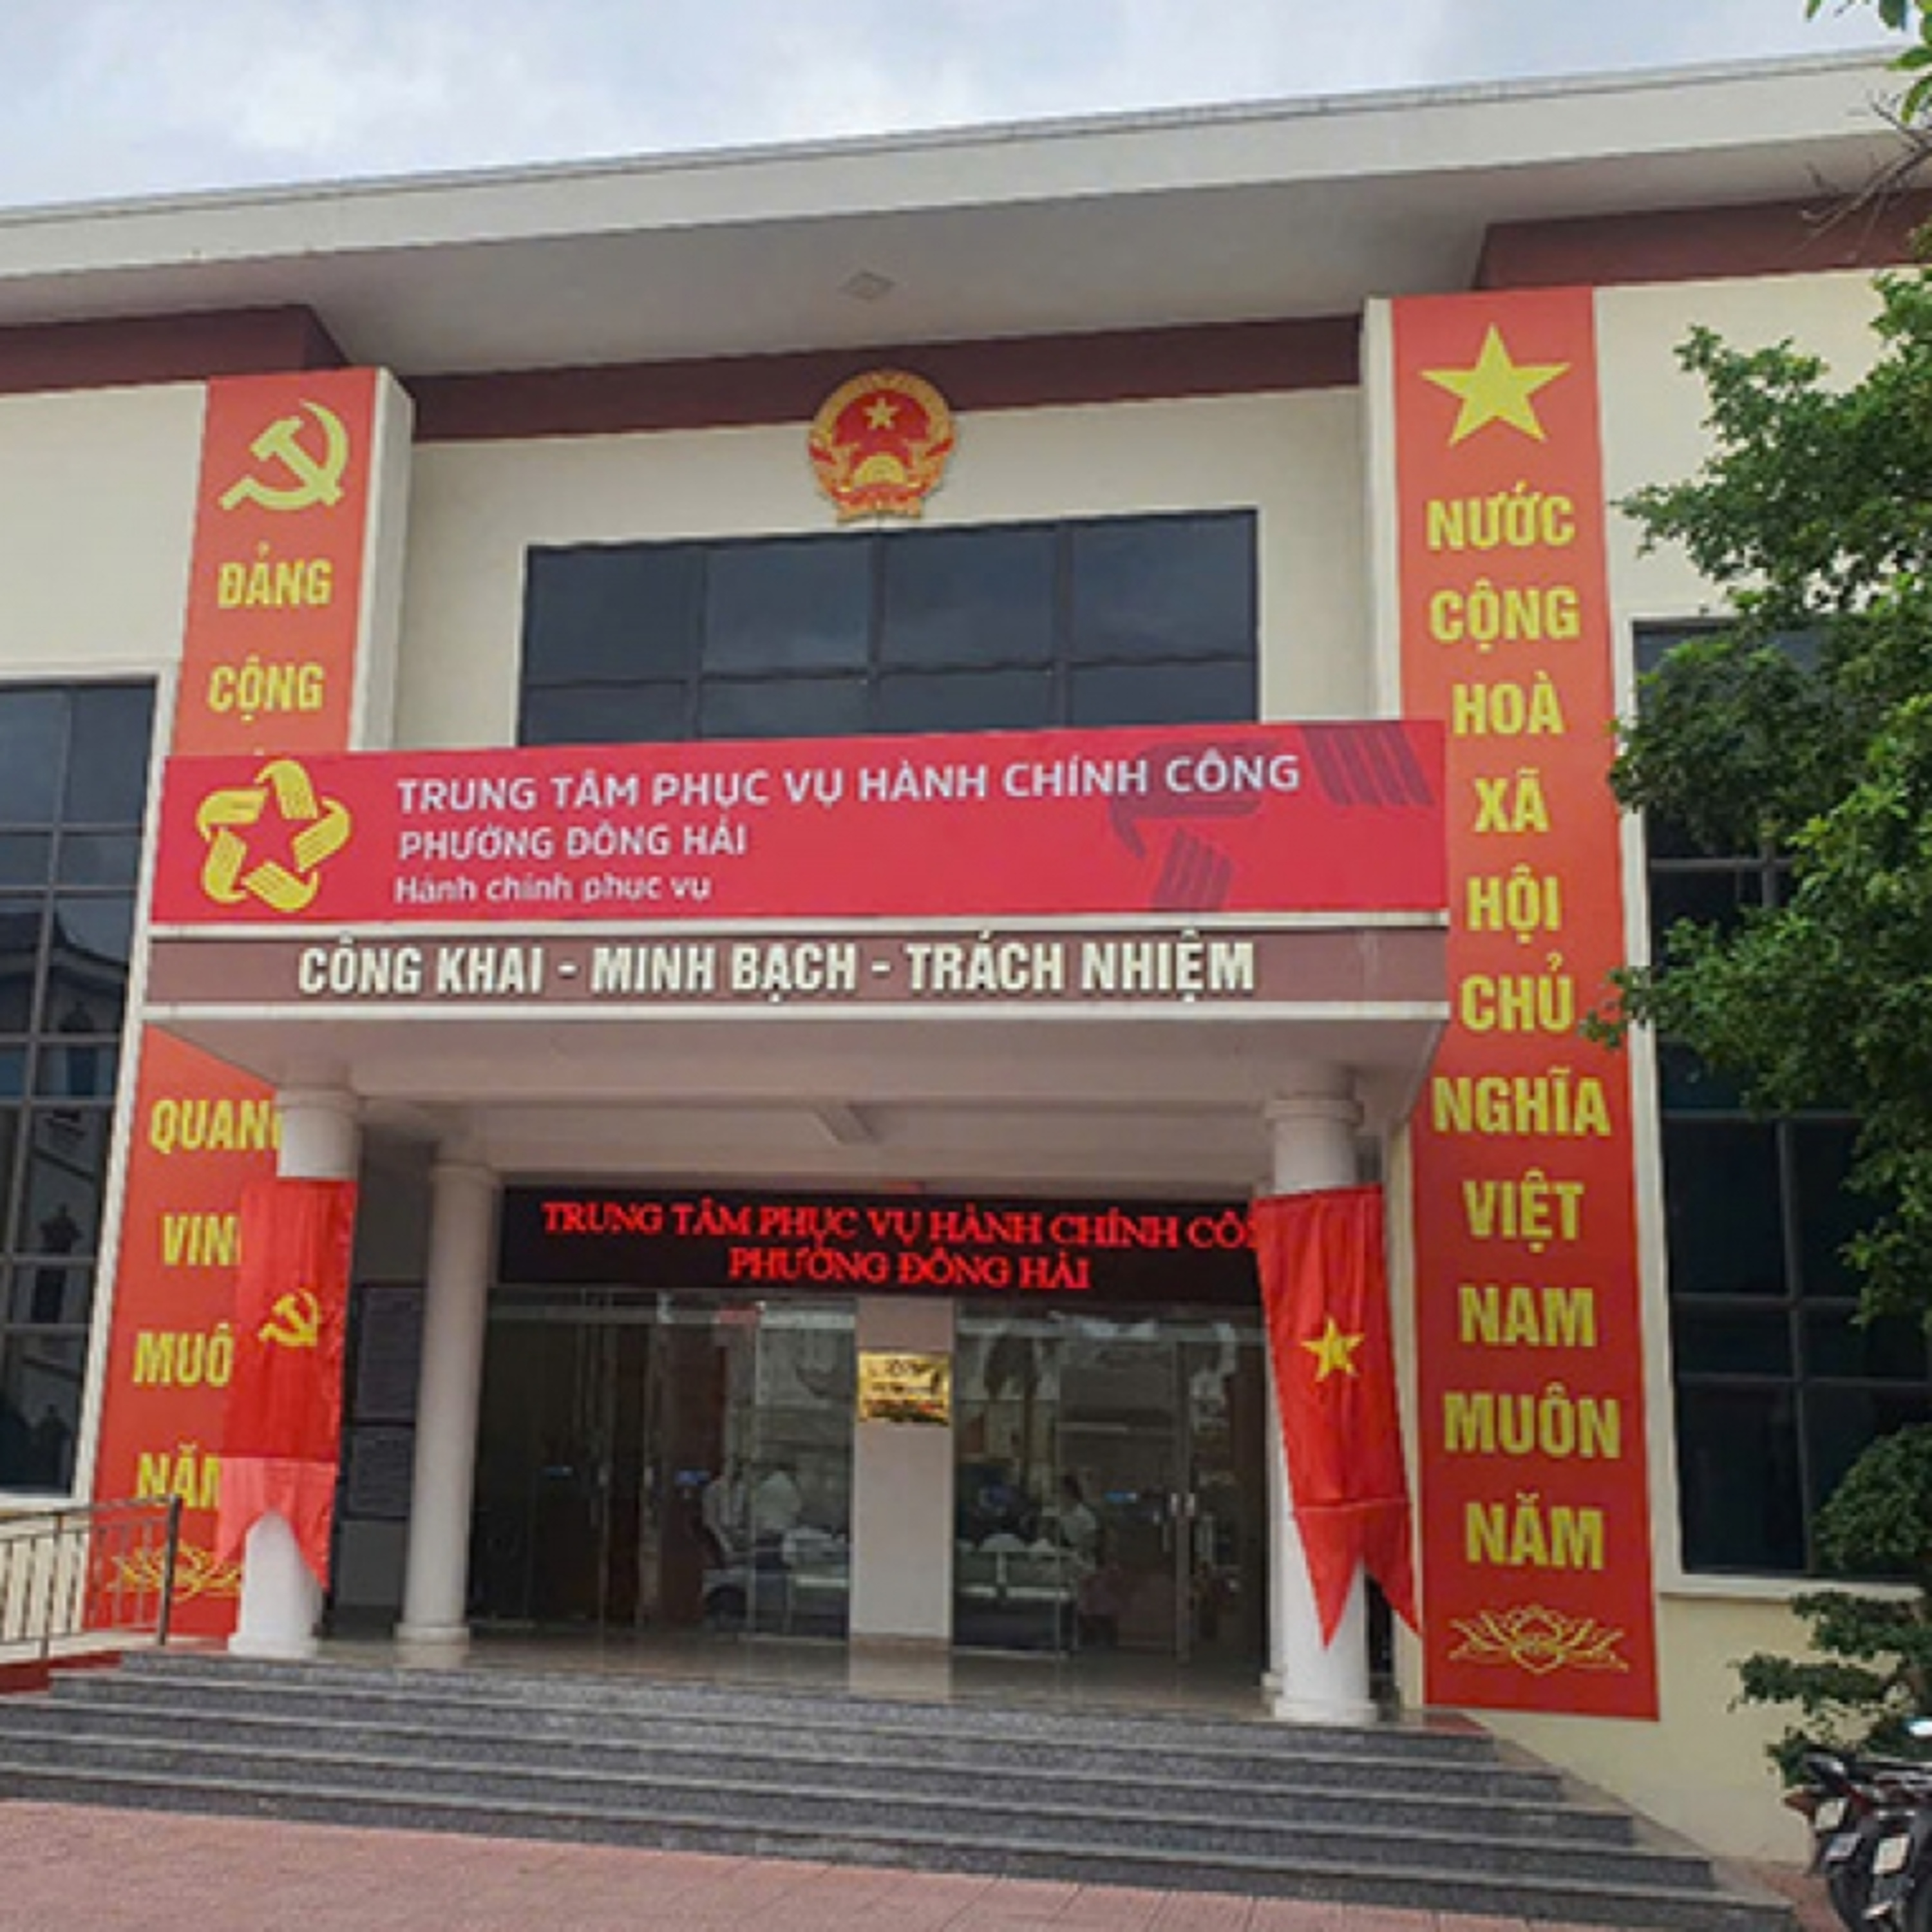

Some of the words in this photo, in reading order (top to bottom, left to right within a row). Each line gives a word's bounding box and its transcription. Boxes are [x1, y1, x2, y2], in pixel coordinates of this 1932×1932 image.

[1426, 481, 1575, 551] NƯỚC
[218, 541, 332, 609] ĐẢNG
[1430, 578, 1580, 653] CỘNG
[207, 656, 324, 723] CỘNG
[1452, 670, 1564, 735] HOÀ
[397, 778, 537, 813] TRUNG
[550, 770, 639, 808] TÂM
[652, 772, 769, 809] PHỤC
[784, 768, 844, 808] VỤ
[858, 759, 988, 800] HÀNH
[1003, 755, 1148, 797] CHÍNH
[1165, 747, 1300, 791] CÔNG
[1475, 766, 1549, 833] XÃ
[399, 822, 554, 860] PHƯỜNG
[566, 820, 670, 857] ĐÔNG
[683, 813, 746, 856] HẢI
[1468, 863, 1561, 943] HỘI
[299, 932, 422, 994] CÔNG
[437, 947, 544, 994] KHAI
[591, 947, 715, 991] MINH
[732, 943, 856, 1003] BẠCH
[907, 930, 1064, 990] TRÁCH
[1081, 928, 1254, 1003] NHIỆM
[1461, 952, 1574, 1030] CHỦ
[1433, 1066, 1611, 1136] NGHĨA
[162, 1215, 242, 1267] VIN
[542, 1202, 663, 1235] TRUNG
[670, 1196, 752, 1235] TÂM
[759, 1206, 858, 1247] PHỤC
[866, 1208, 922, 1247] VỤ
[929, 1203, 1043, 1244] HÀNH
[1049, 1207, 1179, 1249] CHÍNH
[1463, 1168, 1584, 1253] VIỆT
[729, 1240, 890, 1283] PHƯỜNG
[898, 1246, 1012, 1287] ĐÔNG
[1019, 1251, 1090, 1289] HẢI
[1457, 1287, 1594, 1347] NAM
[133, 1322, 234, 1387] MUÔ
[1443, 1383, 1620, 1458] MUÔN
[1465, 1492, 1604, 1569] NĂM
